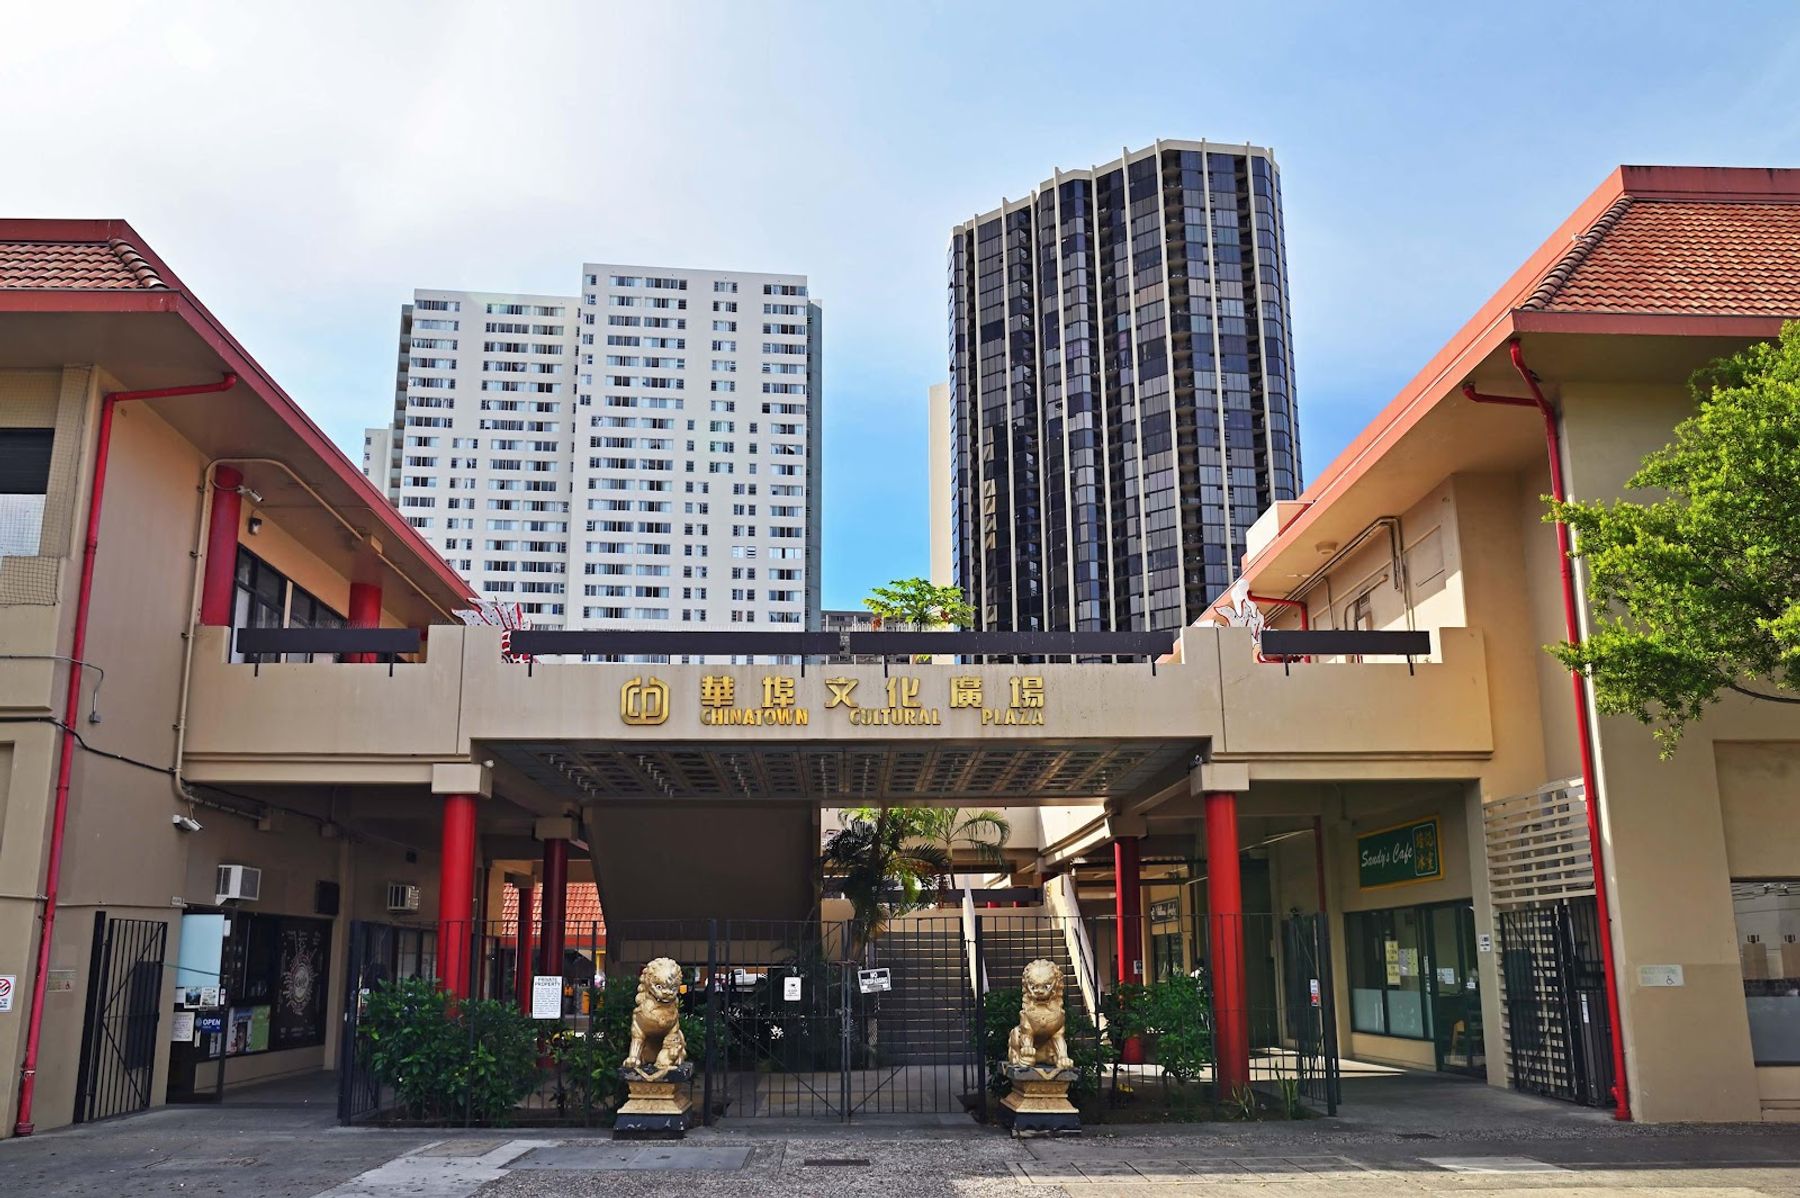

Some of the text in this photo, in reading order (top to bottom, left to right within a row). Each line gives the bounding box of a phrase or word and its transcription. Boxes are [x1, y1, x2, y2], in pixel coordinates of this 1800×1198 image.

[700, 708, 1045, 726] CHINATOWN CULTURAL PLAZA
[1392, 842, 1413, 864] Cafe
[202, 1018, 221, 1026] OPEN
